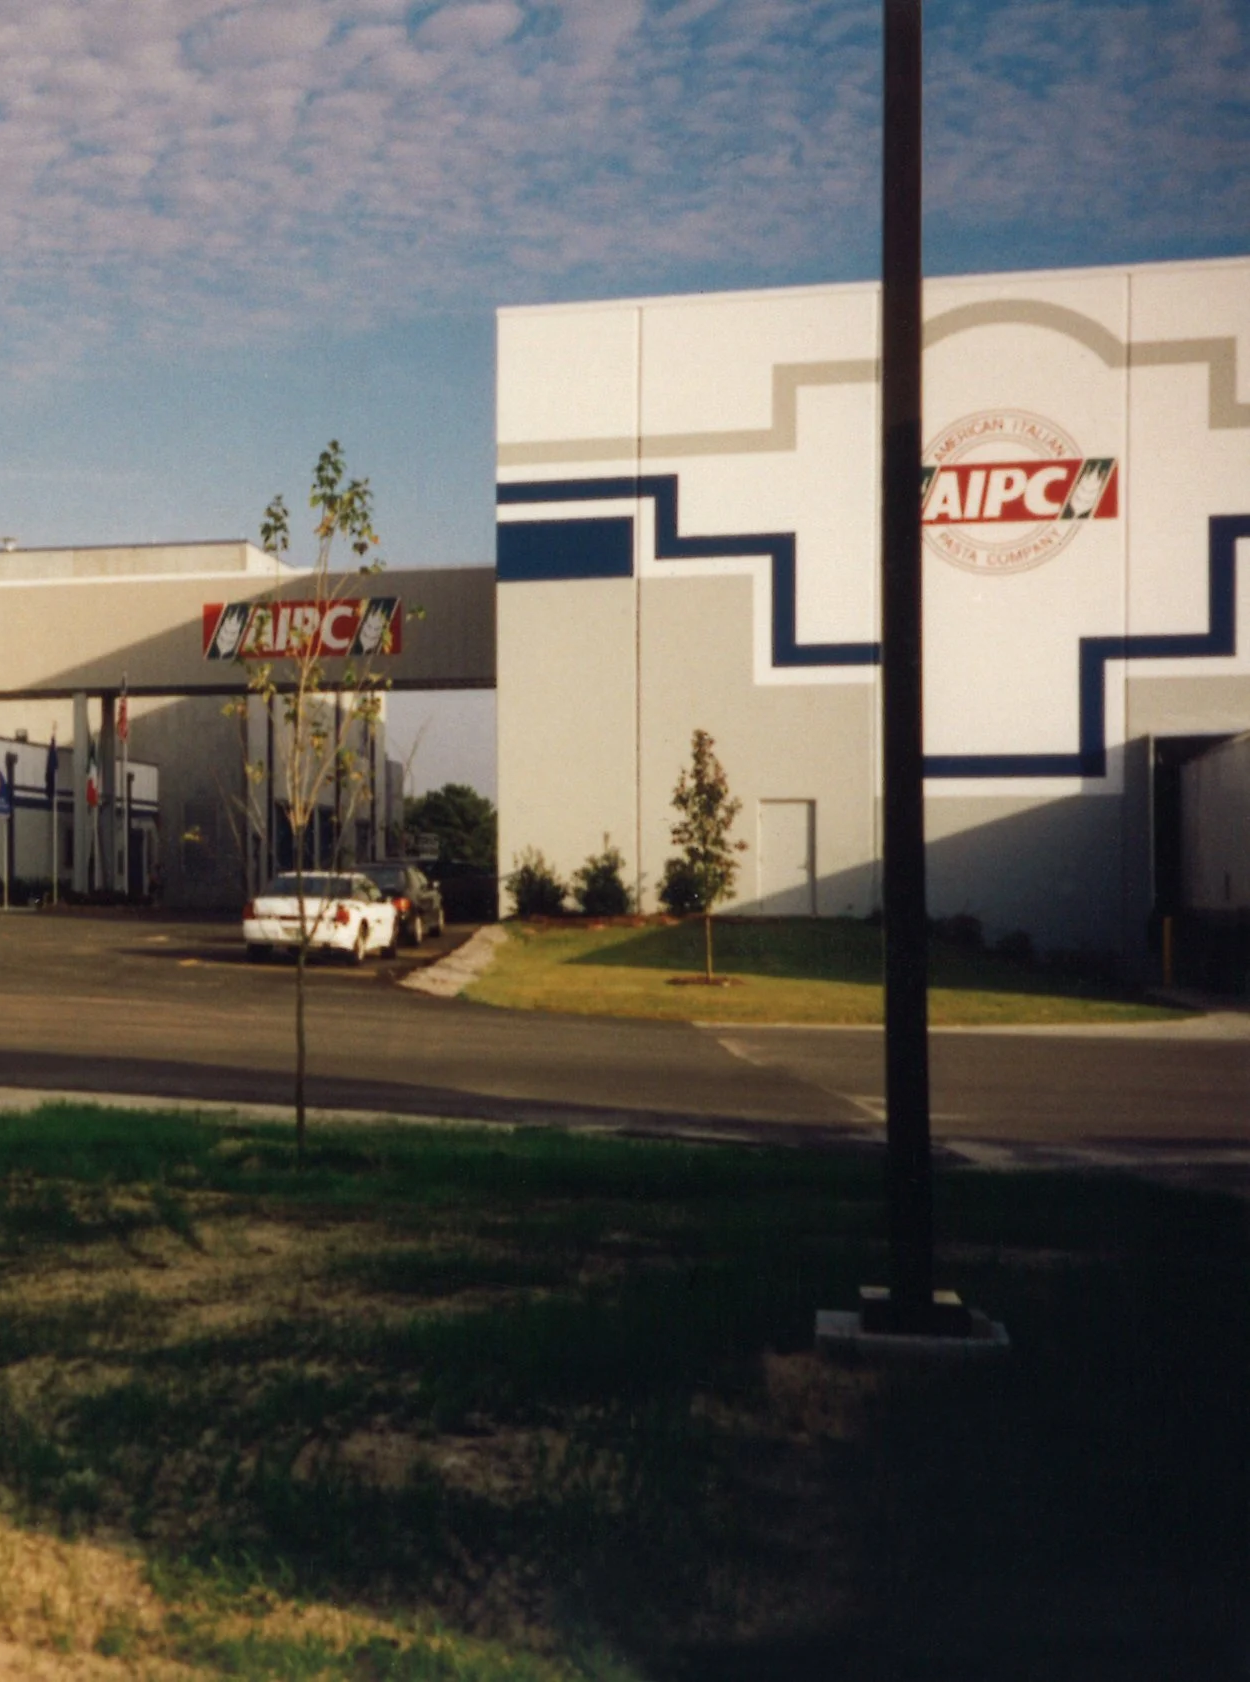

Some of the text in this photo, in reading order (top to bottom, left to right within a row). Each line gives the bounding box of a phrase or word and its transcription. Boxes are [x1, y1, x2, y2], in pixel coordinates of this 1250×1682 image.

[934, 419, 1066, 462] AMERICAN ITALIAN
[923, 467, 1067, 519] AIPC
[939, 526, 1061, 566] PASTA COMPANY
[243, 605, 354, 652] AIPC
